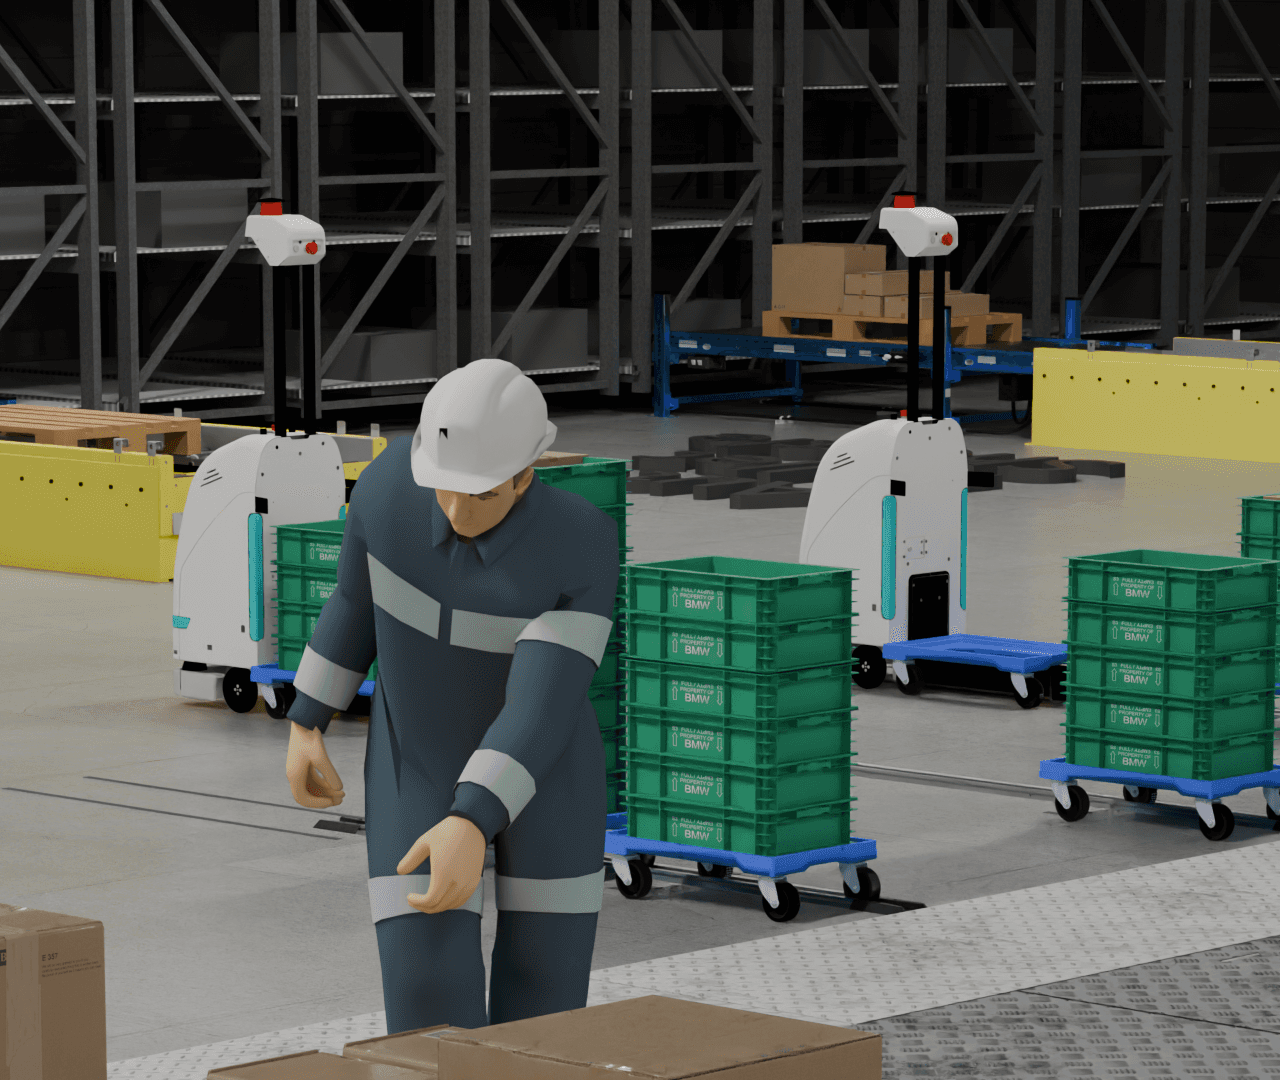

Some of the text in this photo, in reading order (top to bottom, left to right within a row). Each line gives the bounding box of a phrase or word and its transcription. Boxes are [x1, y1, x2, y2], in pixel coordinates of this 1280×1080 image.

[320, 553, 339, 561] BMW
[1125, 588, 1150, 598] BMW
[685, 599, 710, 610] BMW
[1125, 632, 1149, 642] BMW
[685, 645, 710, 656] BMW
[1124, 674, 1148, 685] BMW
[685, 693, 710, 704] BMW
[1123, 716, 1147, 726] BMW
[685, 739, 710, 750] BMW
[1122, 757, 1147, 768] BMW
[685, 784, 709, 796] BMW
[680, 823, 706, 831] PROPERTY
[685, 830, 709, 841] BMW
[48, 952, 58, 960] 357
